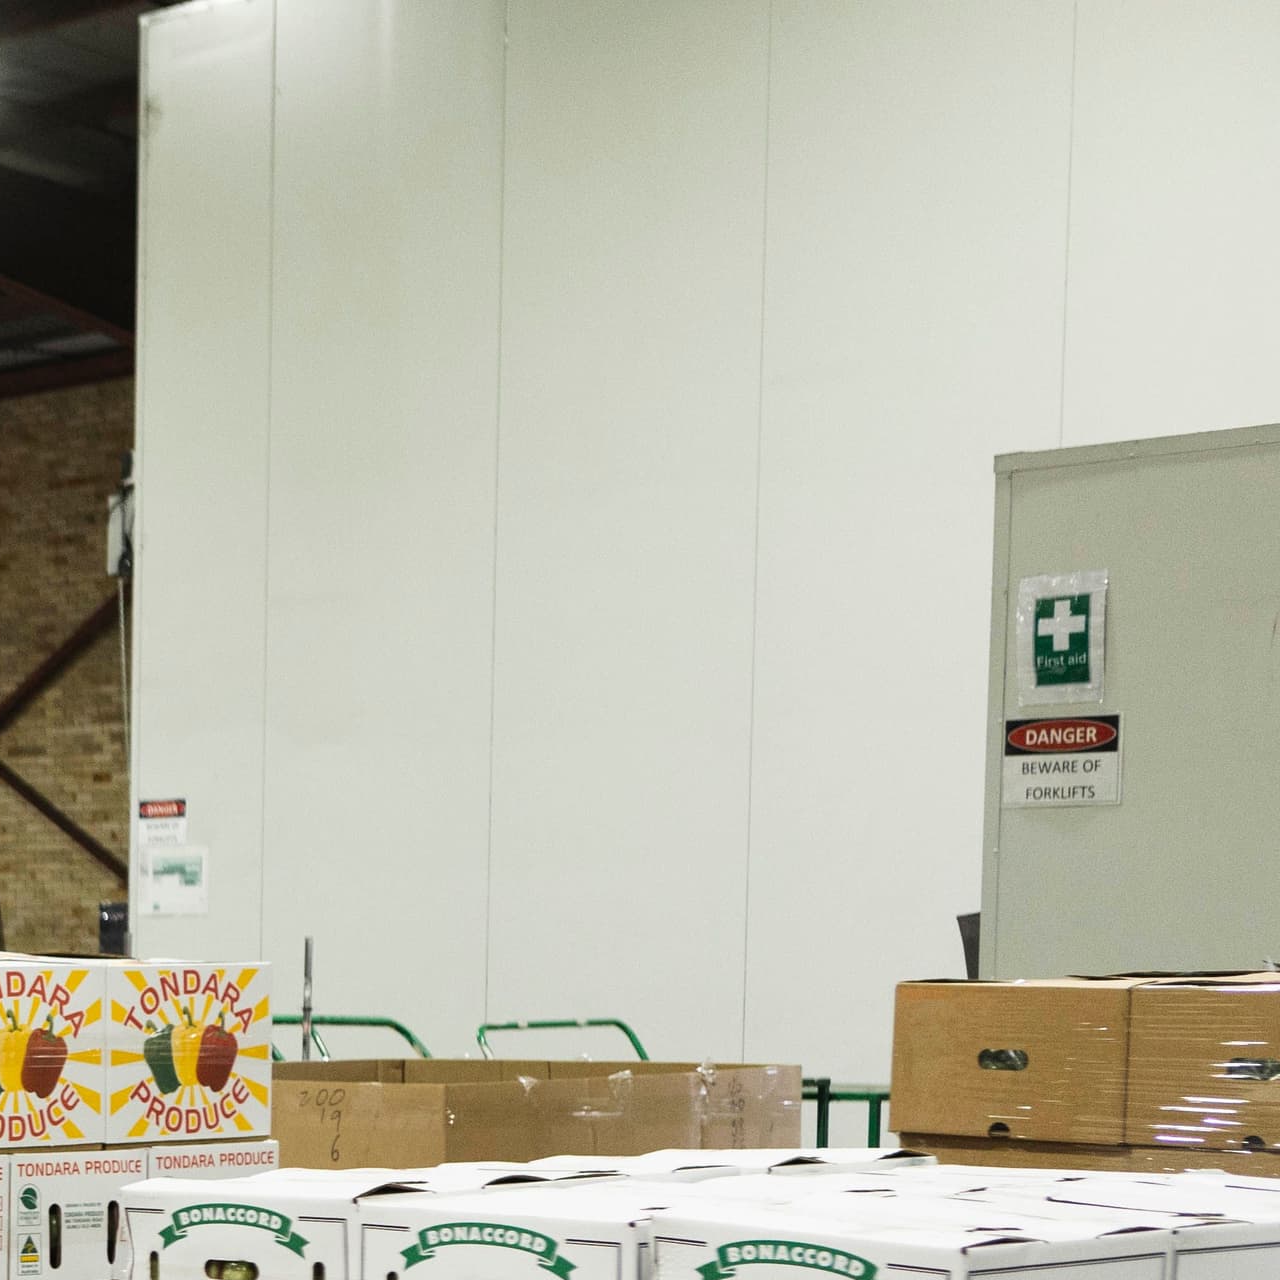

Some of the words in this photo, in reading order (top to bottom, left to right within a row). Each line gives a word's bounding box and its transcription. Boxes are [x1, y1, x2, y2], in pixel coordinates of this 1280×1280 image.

[1037, 655, 1064, 667] First
[1067, 652, 1086, 665] aid
[1025, 727, 1097, 745] DANGER
[1022, 760, 1078, 775] BEWARE
[1083, 759, 1102, 773] OF
[1025, 786, 1095, 800] FORKLIFTS
[124, 968, 254, 1036] TONDARA
[131, 1075, 251, 1135] PRODUCE
[331, 1134, 340, 1161] 6
[17, 1162, 80, 1177] TONDARA
[85, 1160, 142, 1174] PRODUCE
[155, 1153, 215, 1170] TONDARA
[219, 1150, 274, 1167] PRODUCE
[176, 1205, 283, 1232] BONACCORD
[423, 1226, 547, 1253] BONACCORD
[724, 1242, 865, 1277] BONACCORD
